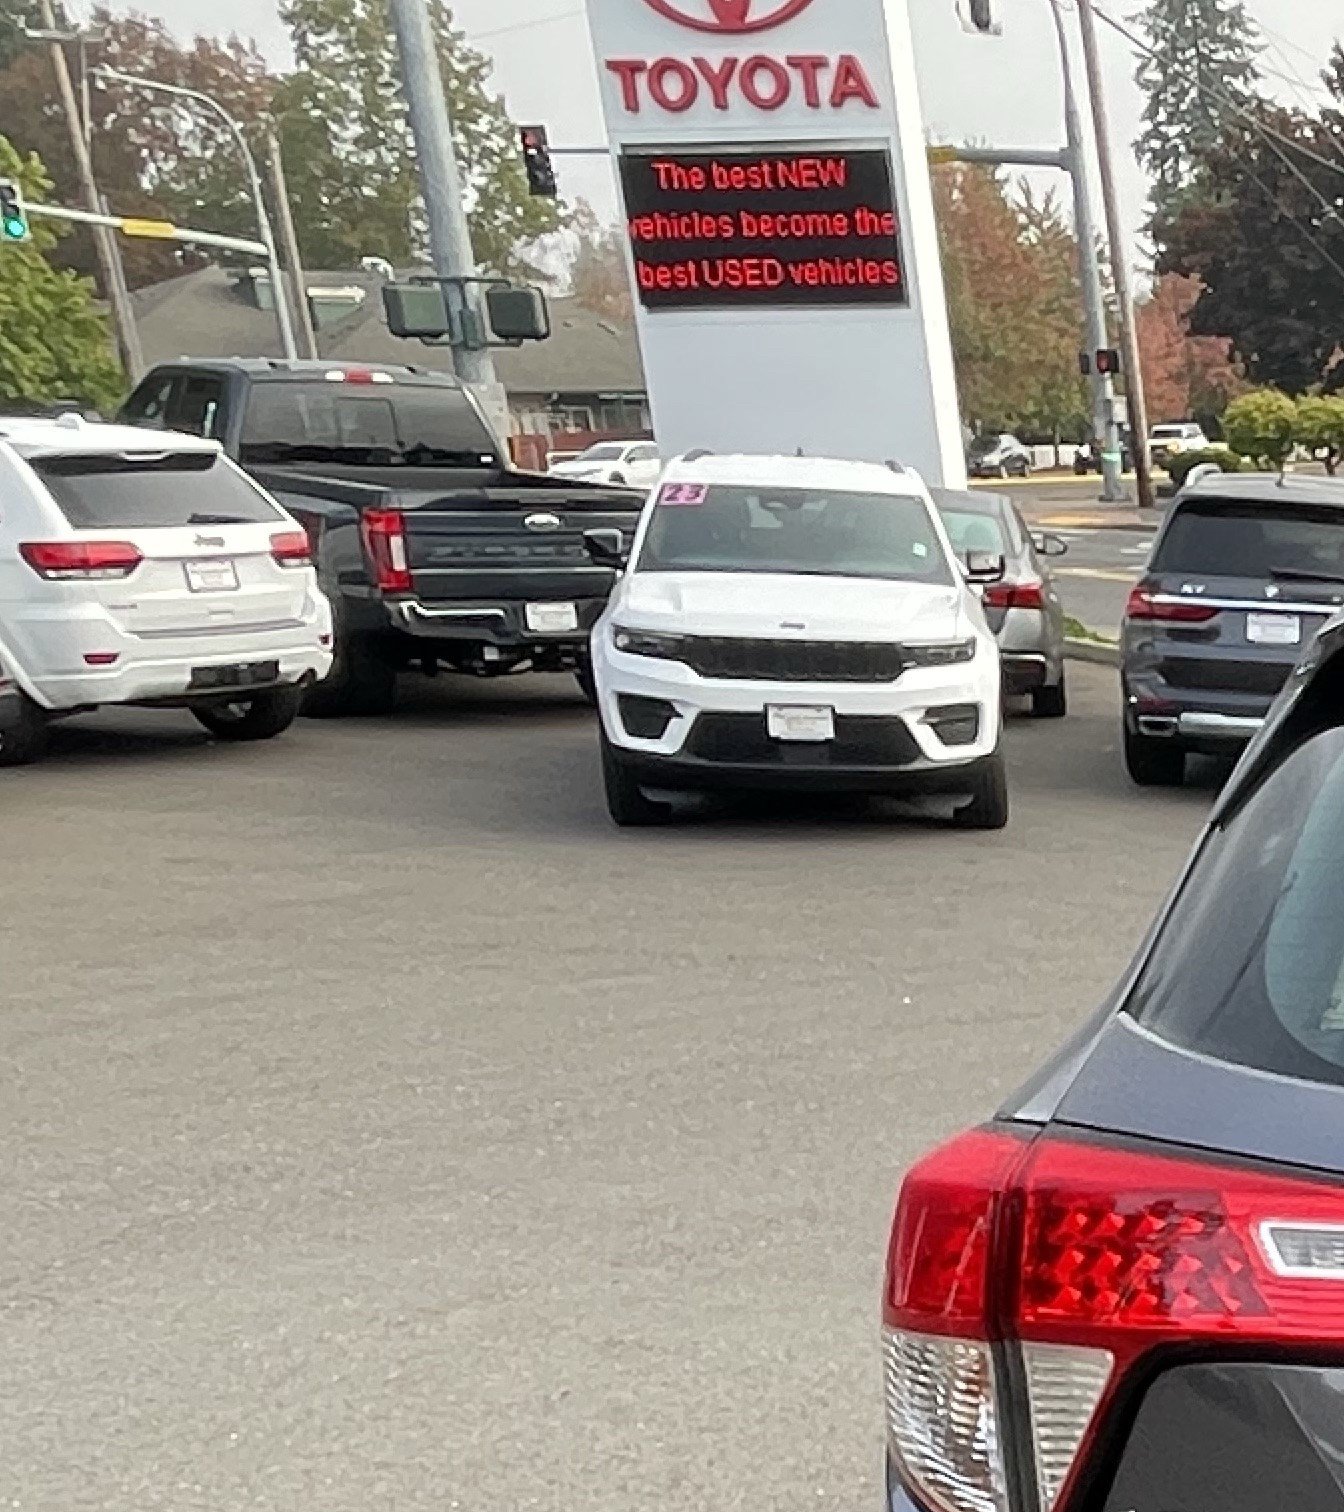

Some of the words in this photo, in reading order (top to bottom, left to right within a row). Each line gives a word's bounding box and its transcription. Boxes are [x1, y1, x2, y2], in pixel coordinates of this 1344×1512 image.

[605, 54, 880, 114] TOYOTA
[651, 160, 705, 190] The
[712, 159, 774, 189] best
[777, 158, 846, 188] NEW
[740, 209, 848, 238] become
[854, 206, 894, 236] the
[636, 260, 698, 288] best
[702, 258, 784, 287] USED
[788, 257, 898, 285] vehicles
